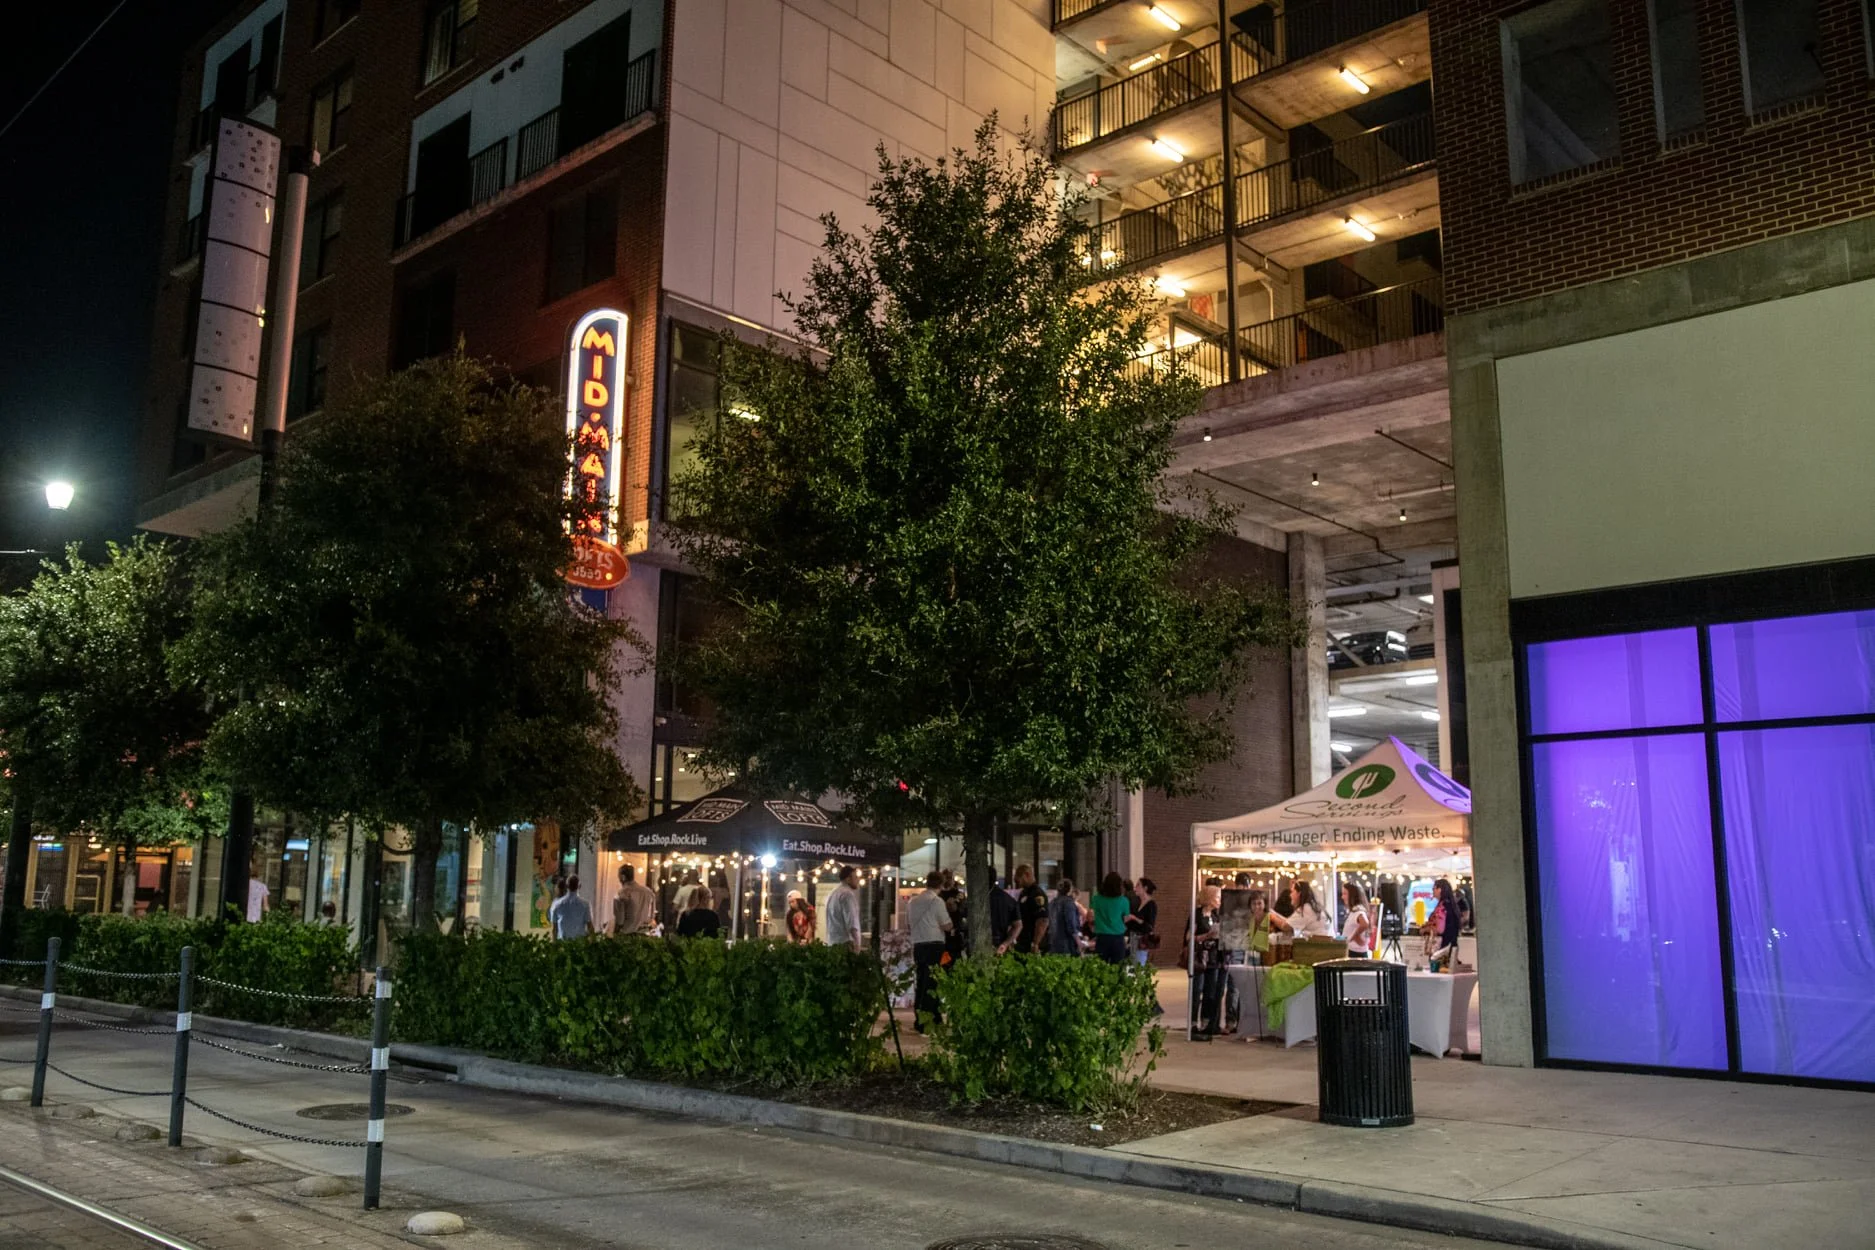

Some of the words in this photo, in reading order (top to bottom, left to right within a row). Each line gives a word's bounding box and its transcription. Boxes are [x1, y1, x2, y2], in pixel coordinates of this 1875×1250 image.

[1284, 794, 1406, 813] Second
[638, 833, 707, 847] Eat.Shop.Rock.Live
[1213, 831, 1268, 848] Fighting
[1272, 830, 1328, 847] Hunger.
[1333, 826, 1385, 845] Ending
[1390, 825, 1445, 841] Waste.
[783, 839, 866, 859] Eat.Shop.Rock.Live
